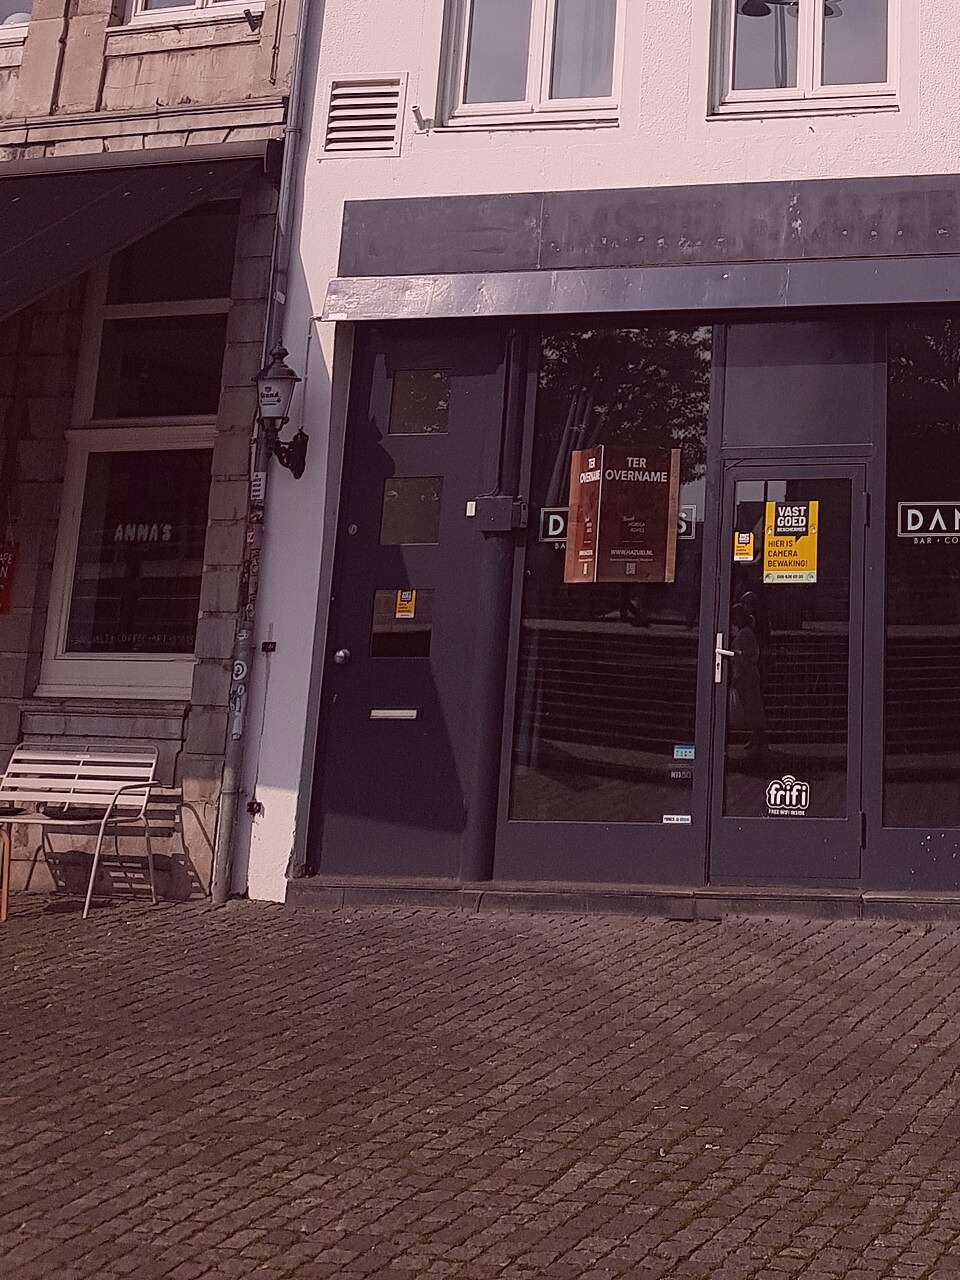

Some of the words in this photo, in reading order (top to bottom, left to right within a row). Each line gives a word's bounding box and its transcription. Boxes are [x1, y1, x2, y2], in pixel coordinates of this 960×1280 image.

[626, 457, 647, 468] TER
[605, 469, 668, 483] OVERNAME
[777, 506, 807, 517] VAST
[776, 516, 807, 527] GOED
[113, 523, 172, 541] ANNA'S
[767, 540, 785, 548] HIER
[767, 550, 798, 558] CAMERA
[767, 559, 808, 567] BEWAKING!
[769, 783, 807, 806] frifi
